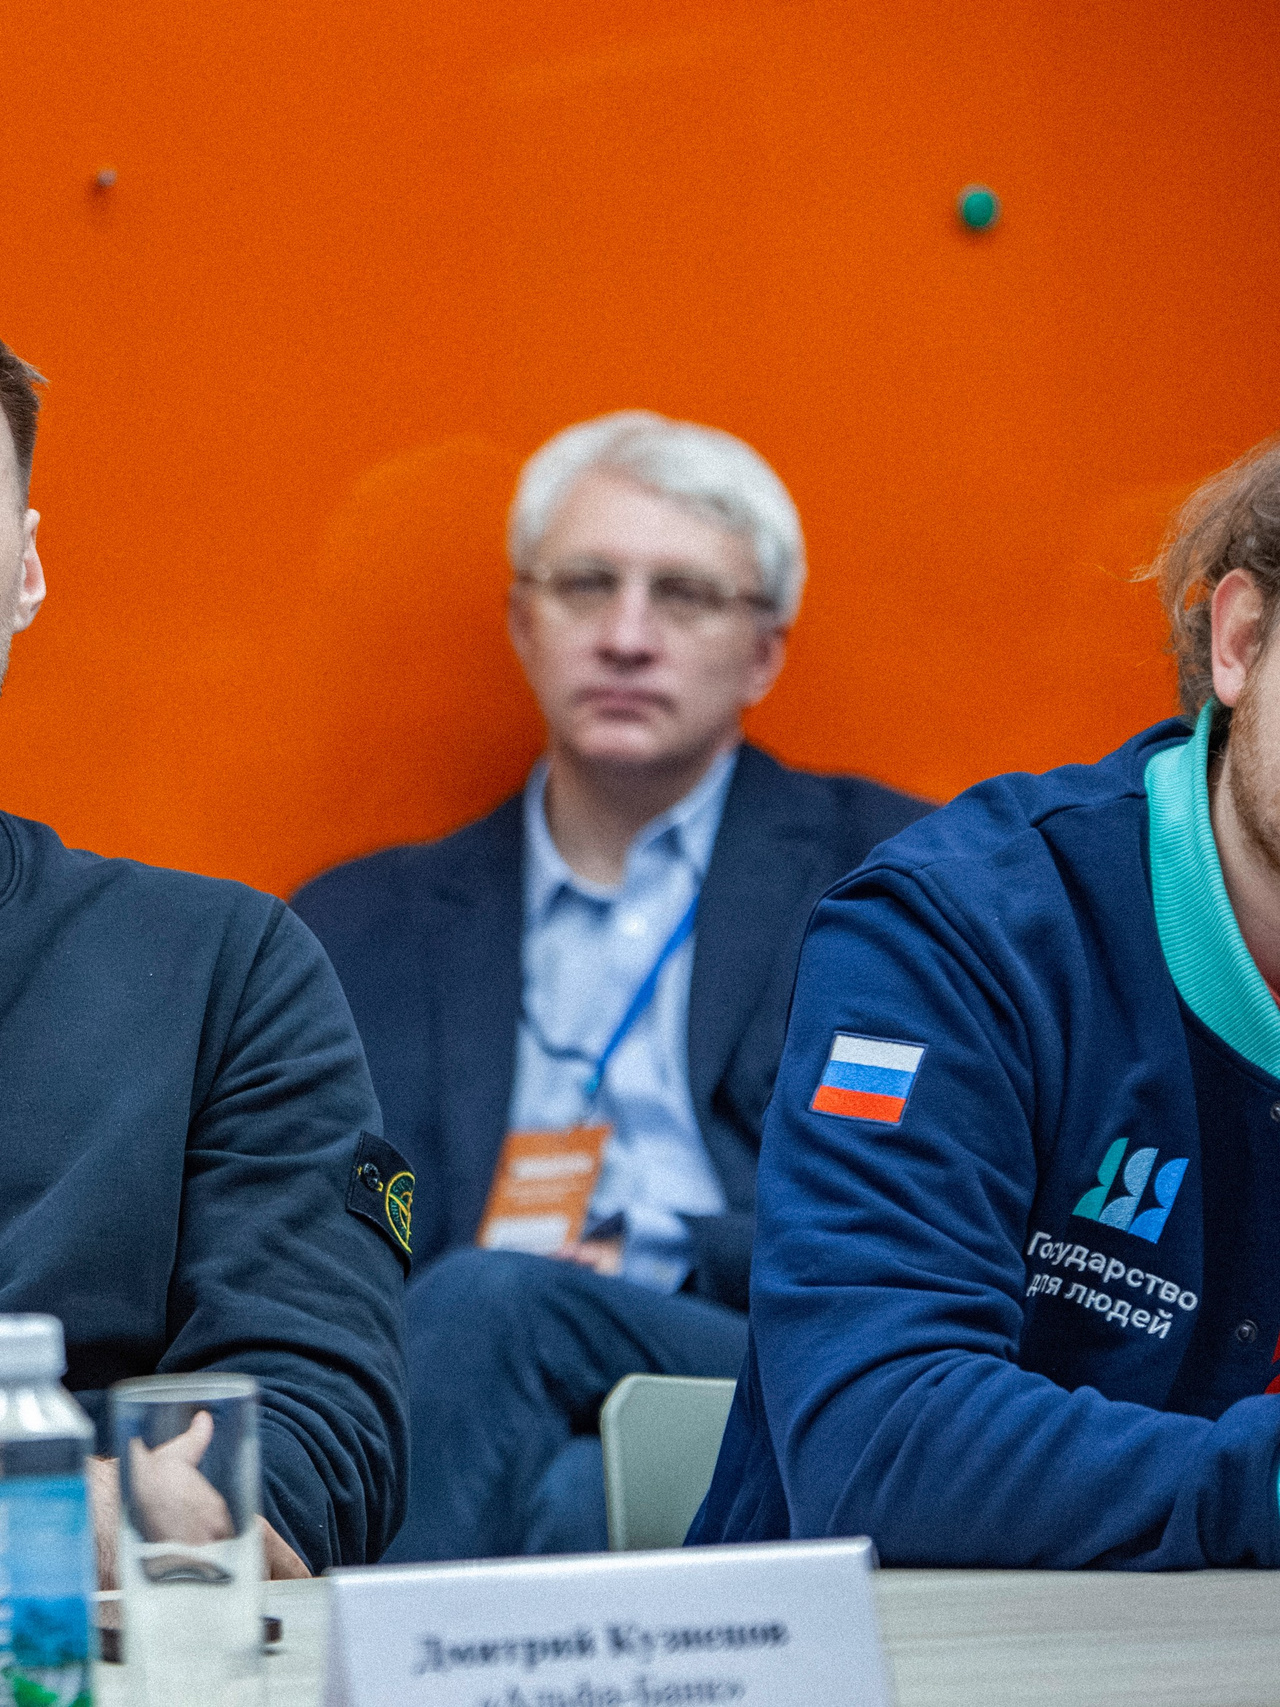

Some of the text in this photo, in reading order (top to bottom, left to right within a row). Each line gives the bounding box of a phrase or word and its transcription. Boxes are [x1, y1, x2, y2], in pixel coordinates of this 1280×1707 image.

[1026, 1273, 1173, 1339] для людей
[1027, 1231, 1198, 1311] Государство
